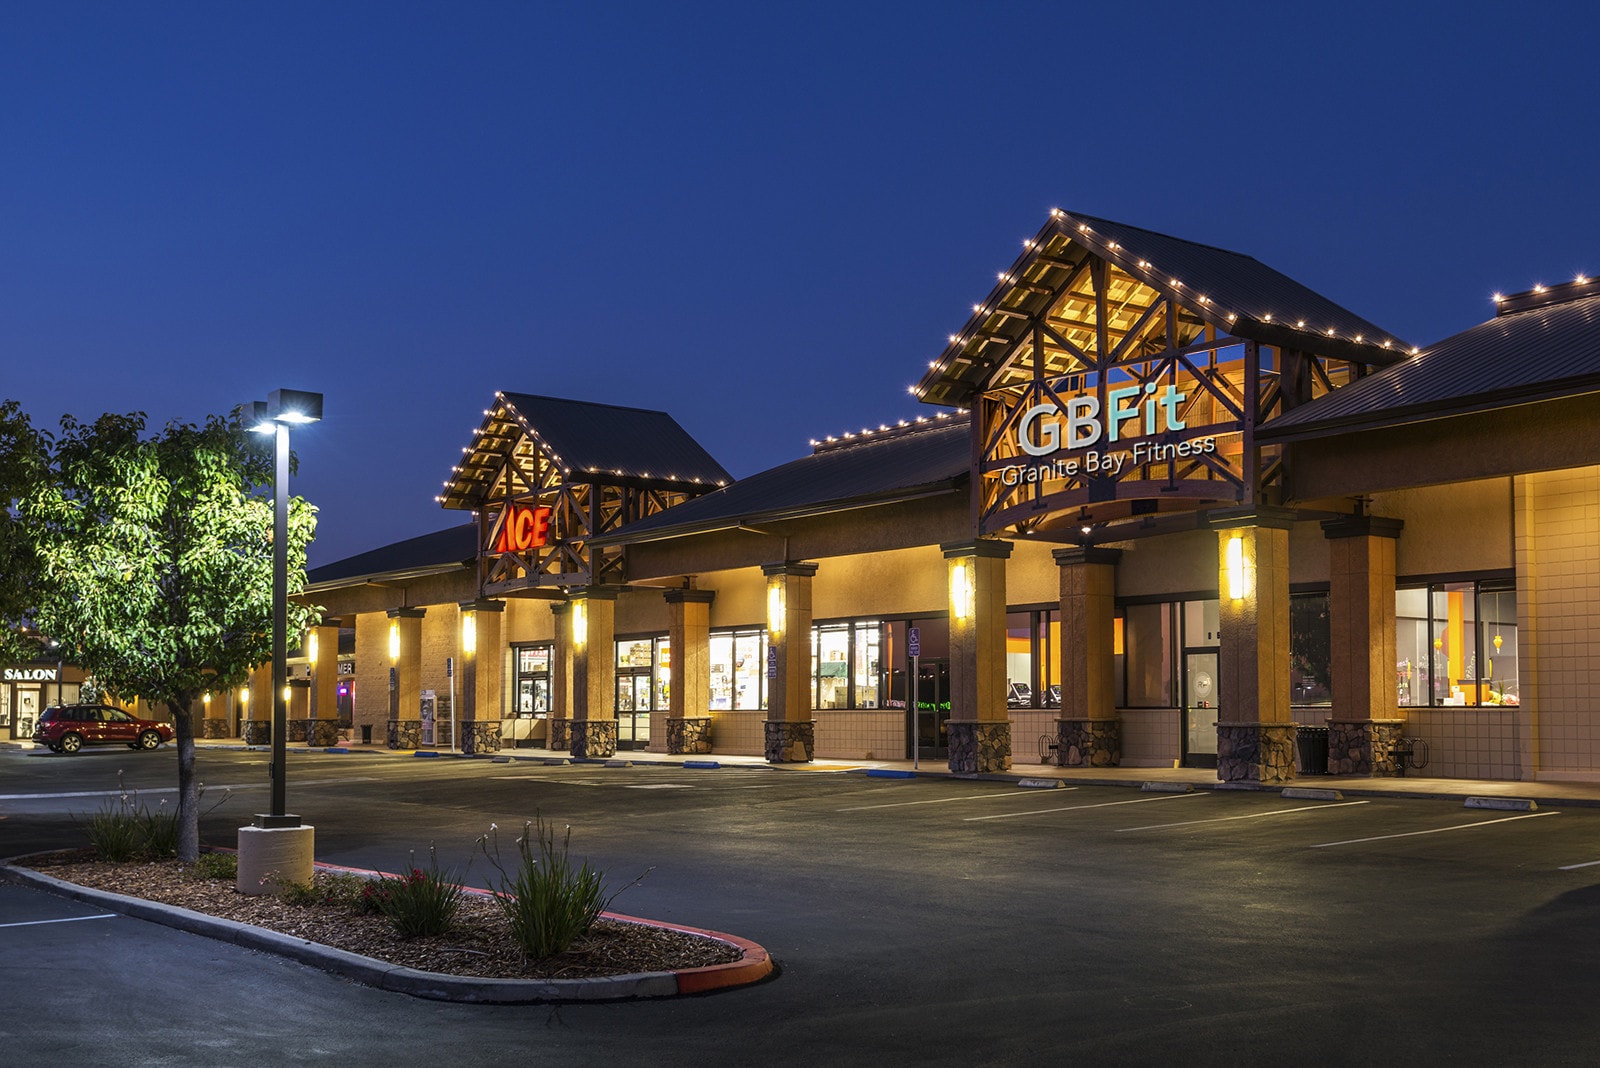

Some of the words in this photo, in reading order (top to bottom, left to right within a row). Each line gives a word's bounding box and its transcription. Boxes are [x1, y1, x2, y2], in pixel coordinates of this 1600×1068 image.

[1018, 383, 1186, 457] GBFit
[1001, 459, 1078, 487] Granite
[1086, 451, 1125, 475] Bay
[1133, 438, 1216, 465] Fitness
[496, 505, 551, 553] ACE
[4, 668, 58, 681] SALON
